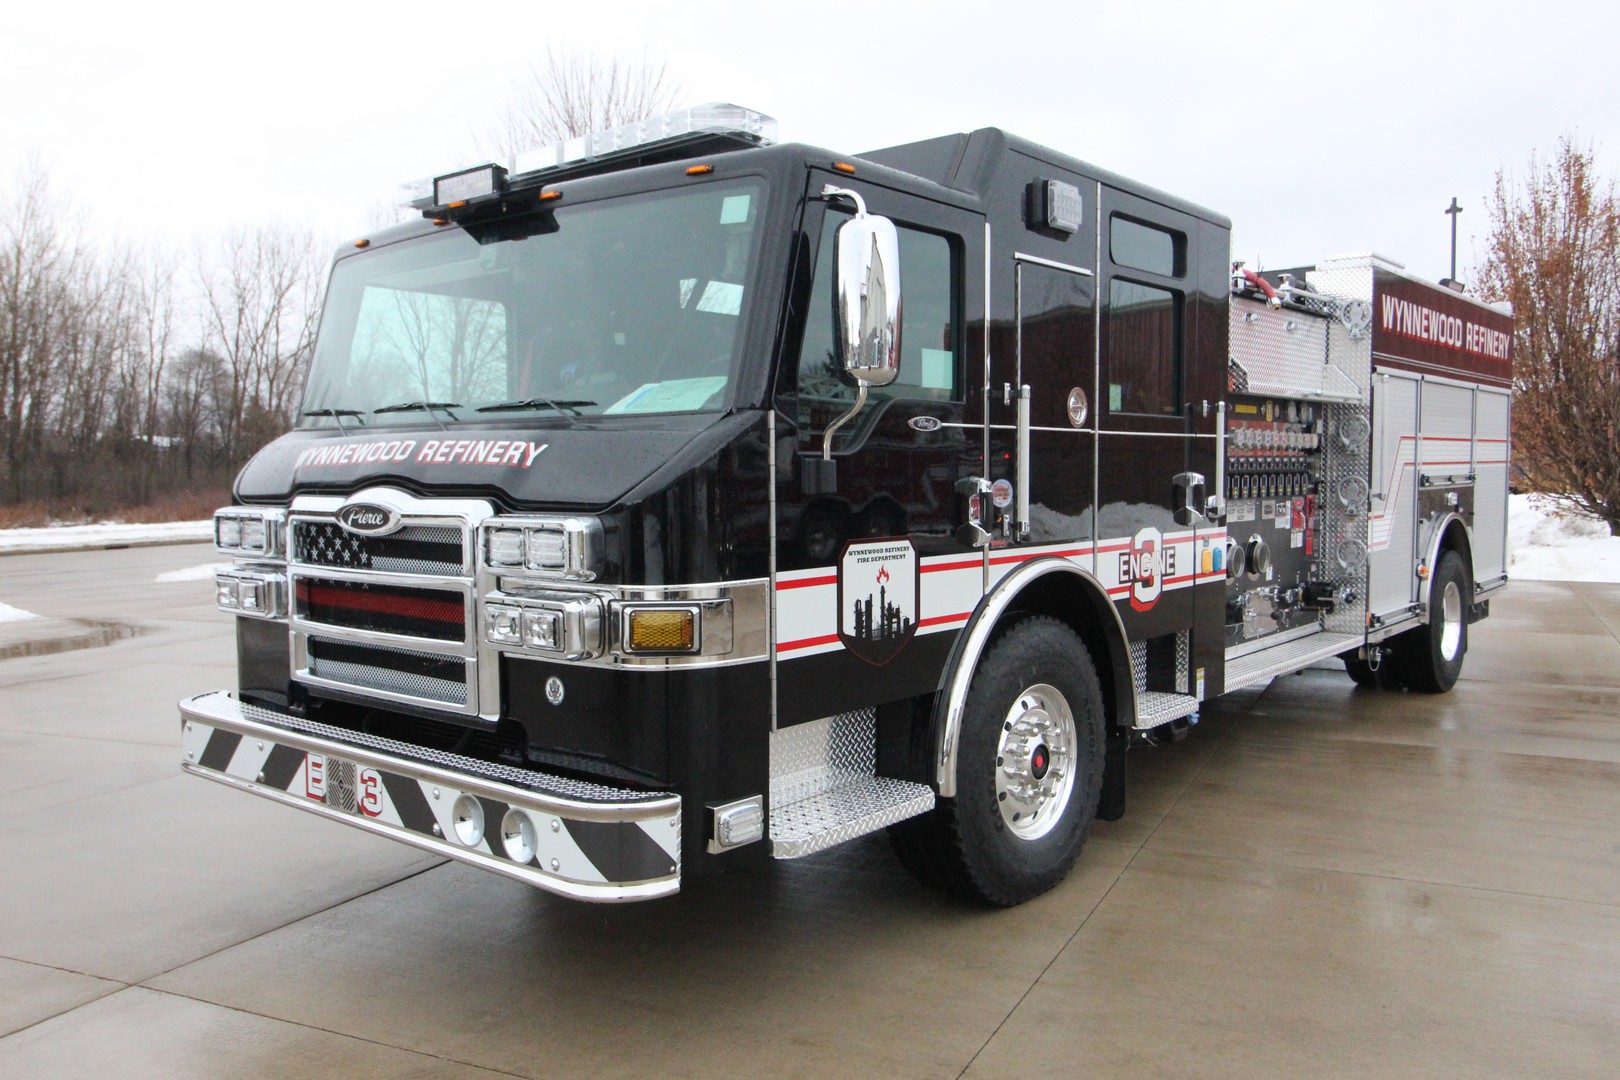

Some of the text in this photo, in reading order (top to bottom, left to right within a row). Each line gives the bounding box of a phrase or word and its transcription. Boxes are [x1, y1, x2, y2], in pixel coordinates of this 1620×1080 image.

[1382, 293, 1511, 360] WYNNEWOOD REFINERY
[295, 440, 549, 469] WYNNEWOOD REFINERY
[347, 508, 384, 526] Pierce
[871, 554, 906, 562] DEPARTMENT
[1119, 546, 1175, 584] ENGINE
[305, 752, 383, 817] E 3
